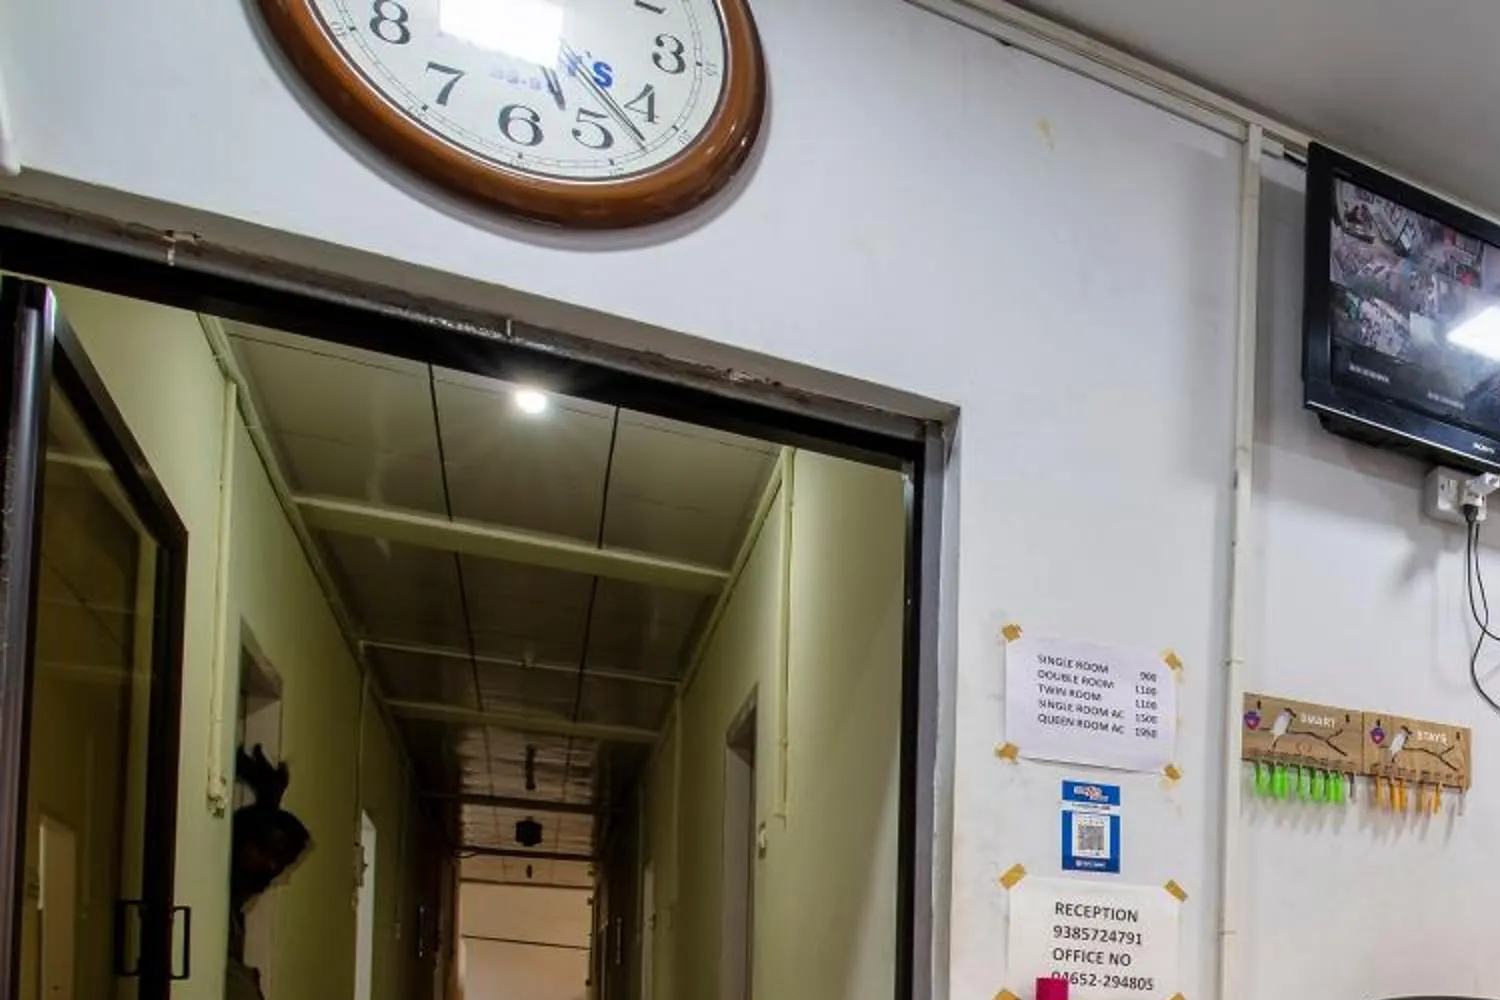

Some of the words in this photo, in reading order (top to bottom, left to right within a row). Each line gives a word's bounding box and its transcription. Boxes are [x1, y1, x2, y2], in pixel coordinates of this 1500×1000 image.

[369, 0, 411, 45] 8
[651, 33, 686, 75] 3
[424, 61, 465, 106] 7
[623, 83, 661, 124] 4
[498, 103, 544, 146] 6
[571, 107, 615, 149] 5
[1037, 654, 1074, 668] SINGLE
[1075, 661, 1109, 674] ROOM
[1037, 669, 1079, 685] DOUBLE
[1081, 675, 1115, 689] ROOM
[1037, 683, 1067, 697] TWIN
[1069, 689, 1102, 702] ROOM
[1038, 699, 1074, 713] SINGLE
[1076, 704, 1109, 718] ROOM
[1037, 713, 1075, 728] QUEEN
[1076, 719, 1109, 732] ROOM
[1055, 901, 1139, 922] RECEPTION
[1053, 925, 1142, 946] 9385724791
[1053, 947, 1105, 965] OFFICE
[1109, 952, 1132, 967] NO
